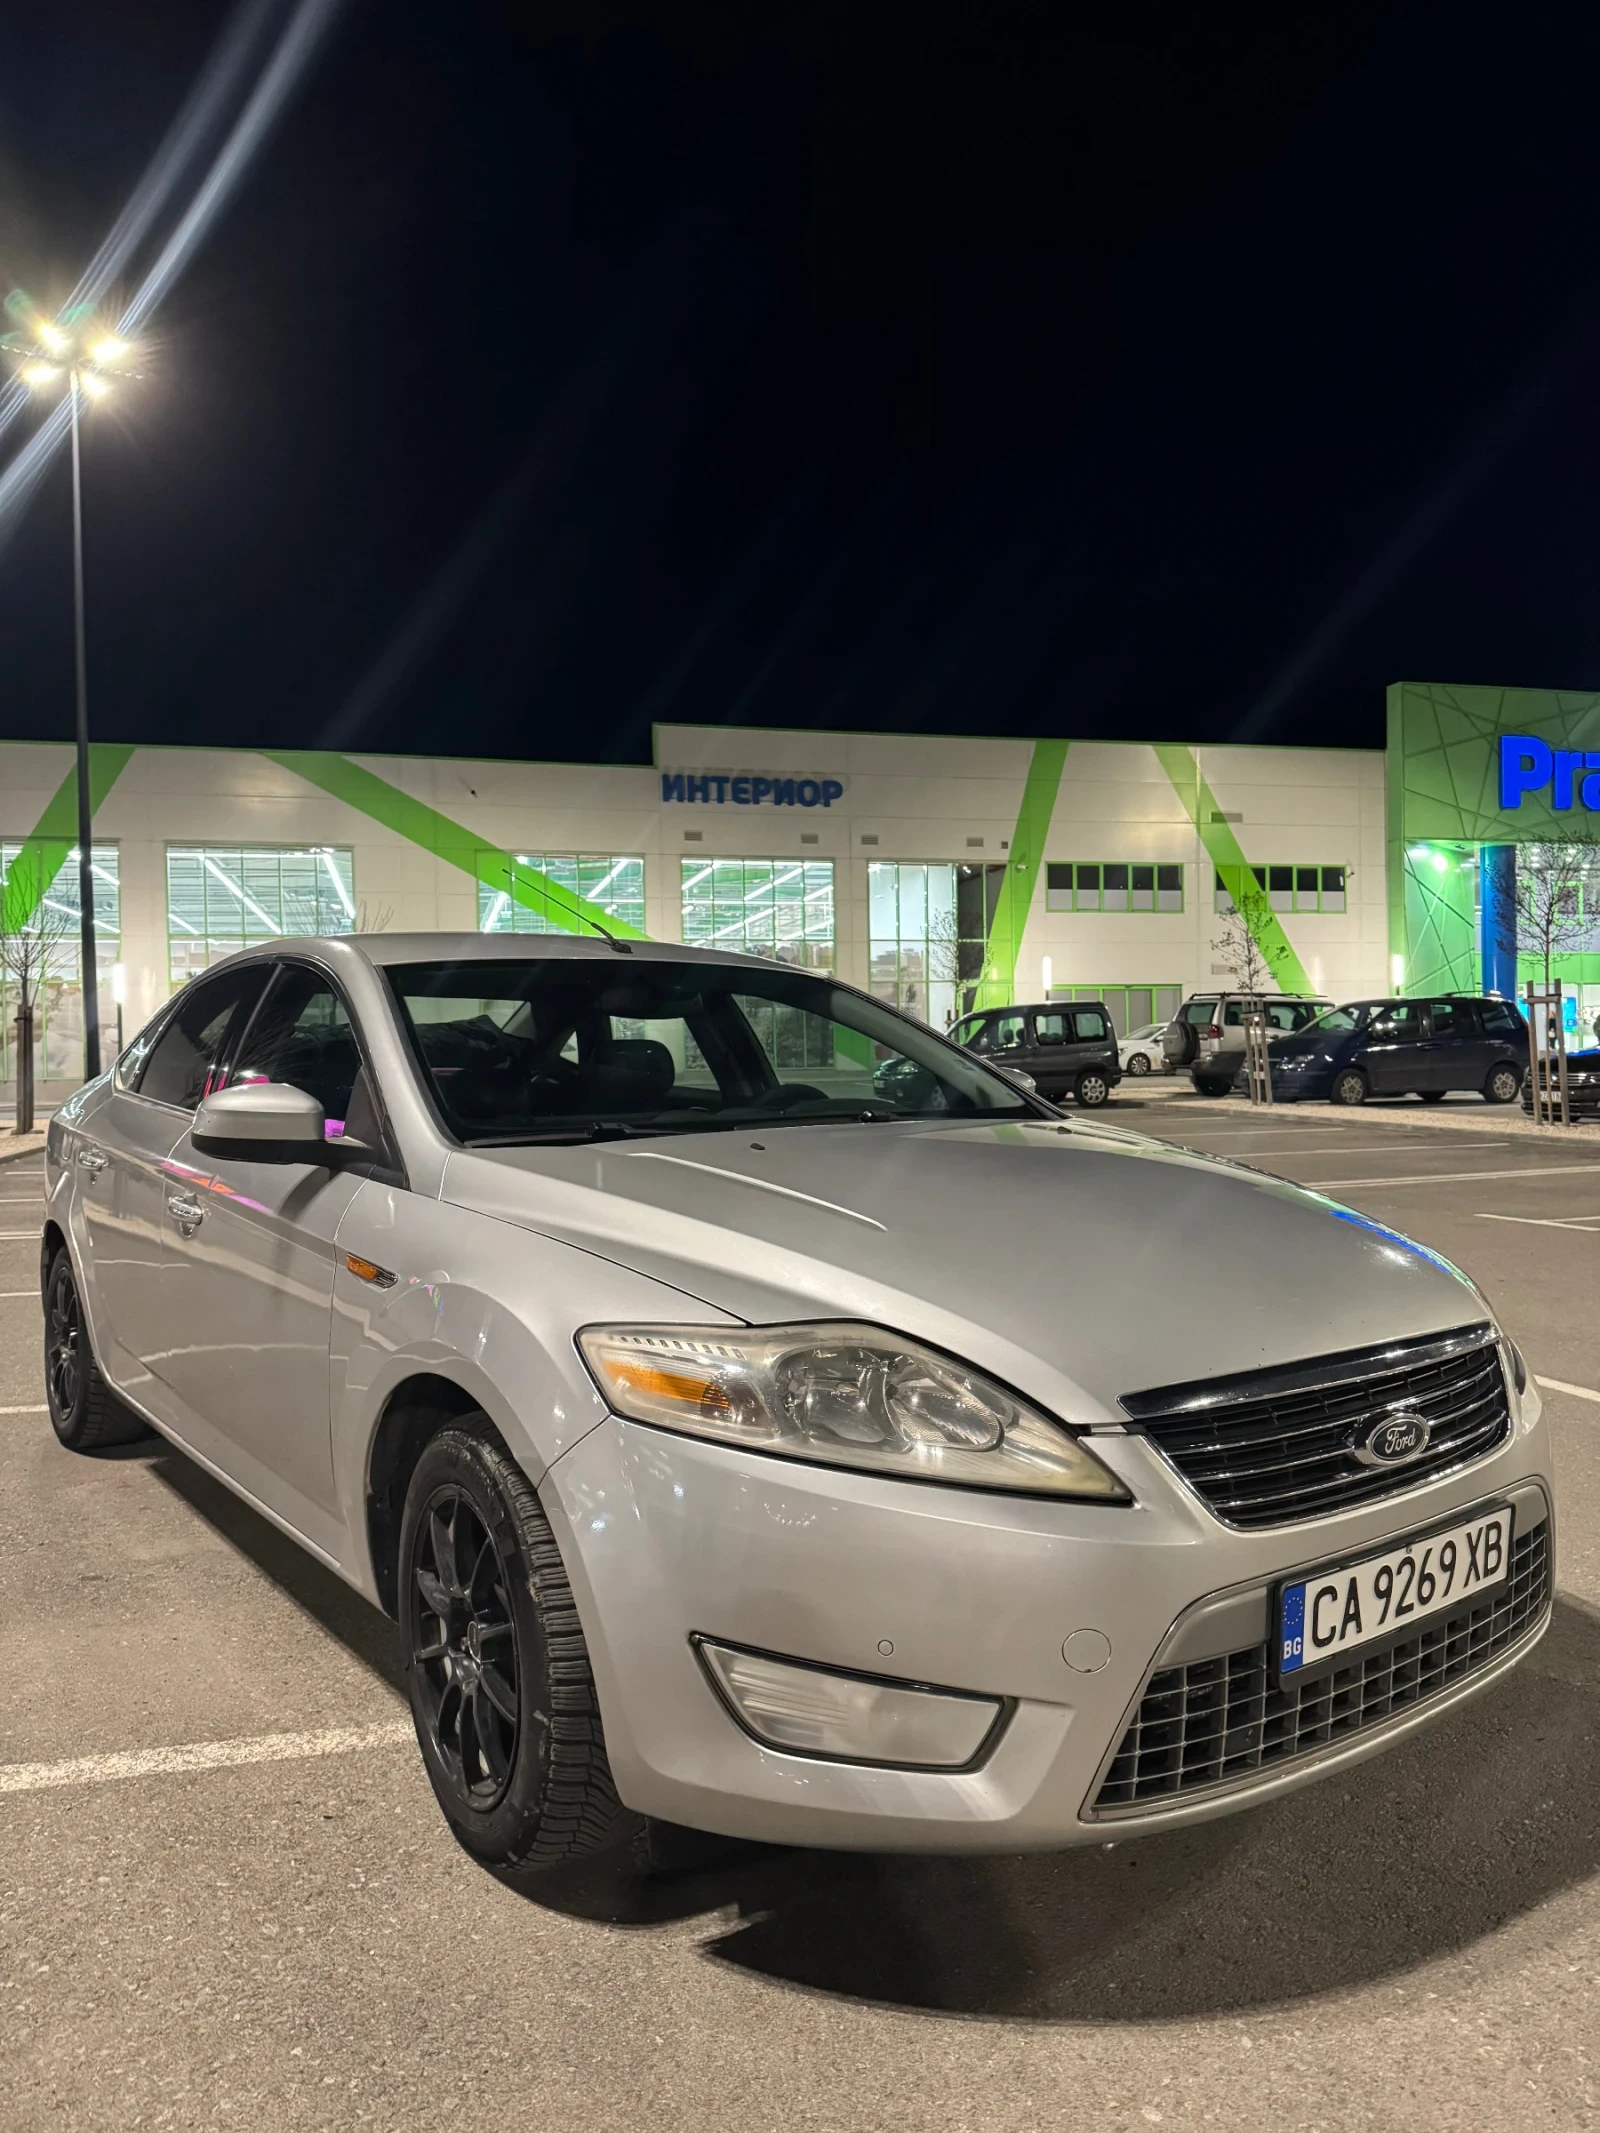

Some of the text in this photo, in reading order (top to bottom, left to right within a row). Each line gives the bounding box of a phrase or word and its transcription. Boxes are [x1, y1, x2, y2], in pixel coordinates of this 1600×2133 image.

[661, 774, 843, 807] ИНТЕРИОР
[1385, 1425, 1416, 1454] Ford
[1312, 1520, 1502, 1648] CA 9269 XB
[1283, 1636, 1302, 1660] BG
